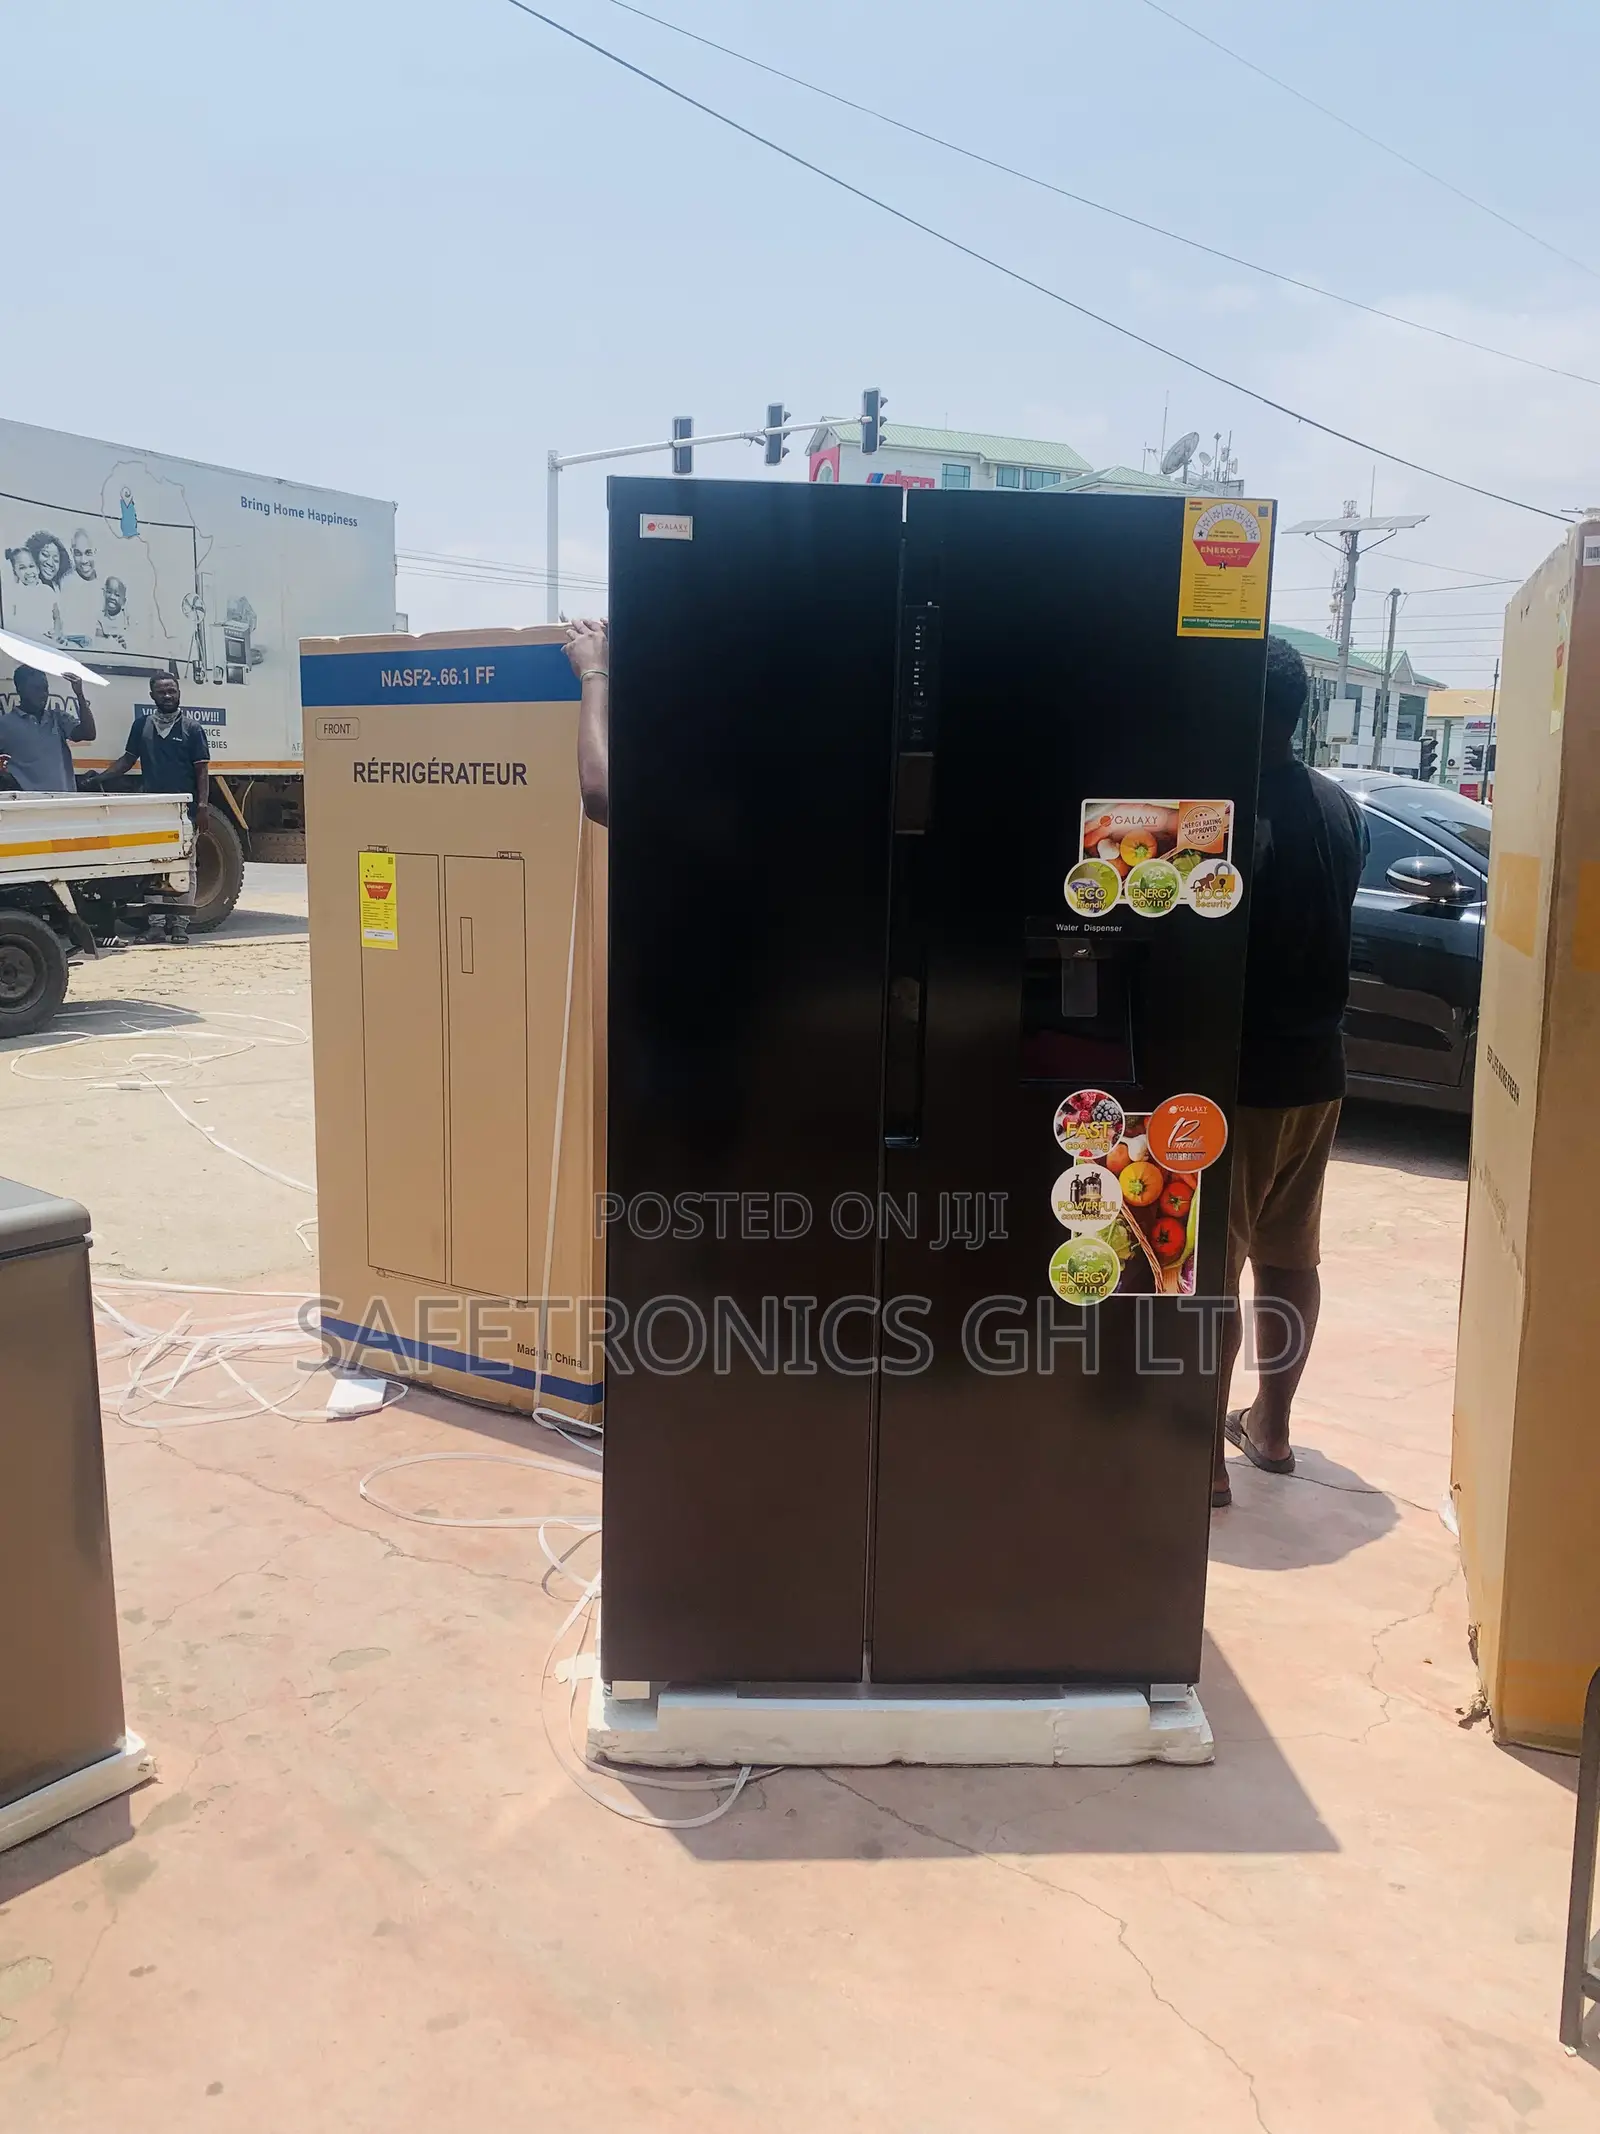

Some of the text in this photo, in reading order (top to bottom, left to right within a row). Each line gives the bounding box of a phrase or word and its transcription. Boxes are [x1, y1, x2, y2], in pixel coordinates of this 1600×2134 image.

[240, 496, 358, 527] Bring Home Happiness
[1200, 546, 1241, 555] ENERGY
[475, 666, 495, 685] FF
[186, 711, 220, 722] NOW!!!
[204, 729, 221, 737] RICE
[323, 723, 351, 735] FRONT
[207, 740, 228, 749] EBIES
[353, 757, 528, 785] RÉFRIGÉRATEUR
[1114, 815, 1159, 825] GALAXY
[1202, 817, 1222, 827] RATING
[1188, 826, 1218, 835] APPROVED
[1076, 887, 1108, 900] ECO
[1132, 887, 1173, 900] ENERGY
[1195, 888, 1232, 901] LOCK
[1076, 899, 1107, 910] friendly
[1132, 899, 1172, 910] saving
[1195, 899, 1233, 910] Security
[1056, 923, 1123, 933] Water Dispenser
[1065, 1121, 1112, 1139] FAST
[1167, 1117, 1201, 1149] 12
[1065, 1139, 1111, 1151] cooling
[1165, 1151, 1206, 1161] WARRANTY
[1058, 1201, 1119, 1213] POWERFUL
[1061, 1213, 1113, 1222] compressor
[1059, 1272, 1108, 1284] ENERGY
[1058, 1284, 1108, 1296] saving
[555, 1353, 583, 1369] China
